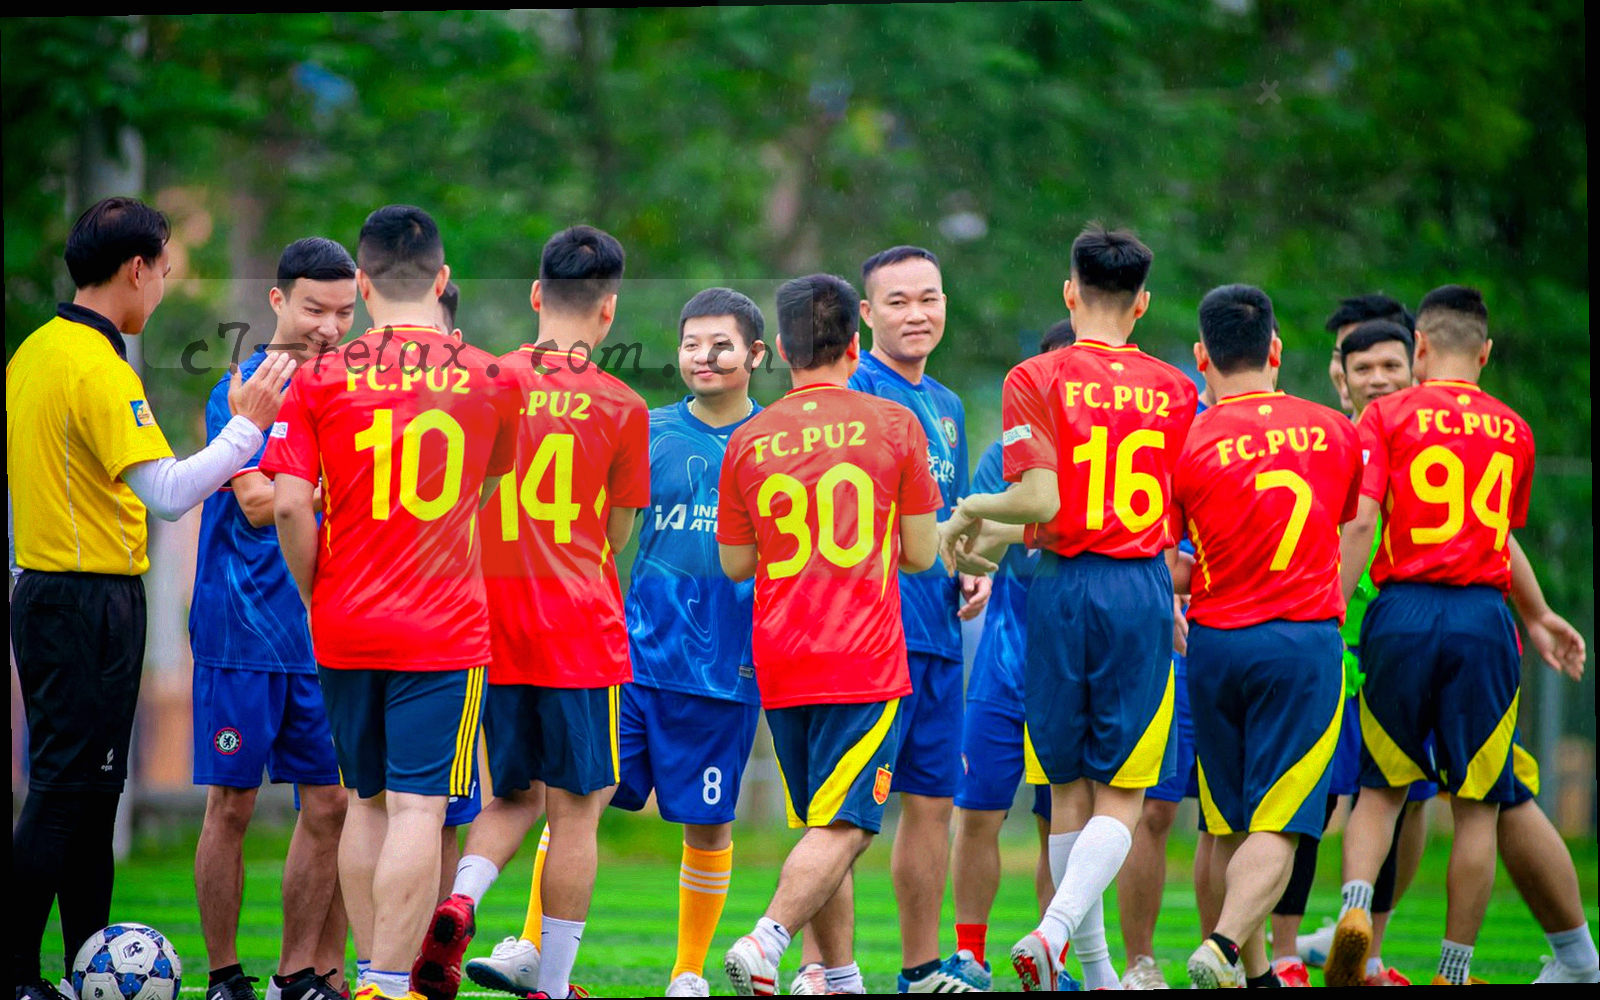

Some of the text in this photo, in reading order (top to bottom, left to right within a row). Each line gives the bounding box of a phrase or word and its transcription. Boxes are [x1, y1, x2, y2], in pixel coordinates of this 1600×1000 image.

[346, 364, 471, 394] FC.PU2
[1065, 381, 1171, 417] FC.PU2
[753, 421, 867, 464] FC.PU2
[1216, 426, 1328, 466] FC.PU2
[1417, 408, 1517, 444] FC.PU2
[354, 409, 466, 521] 10
[500, 433, 582, 544] 14
[1073, 425, 1165, 534] 16
[1409, 444, 1514, 552] 94
[757, 462, 875, 580] 30
[1255, 469, 1313, 571] 7
[702, 766, 722, 805] 8
